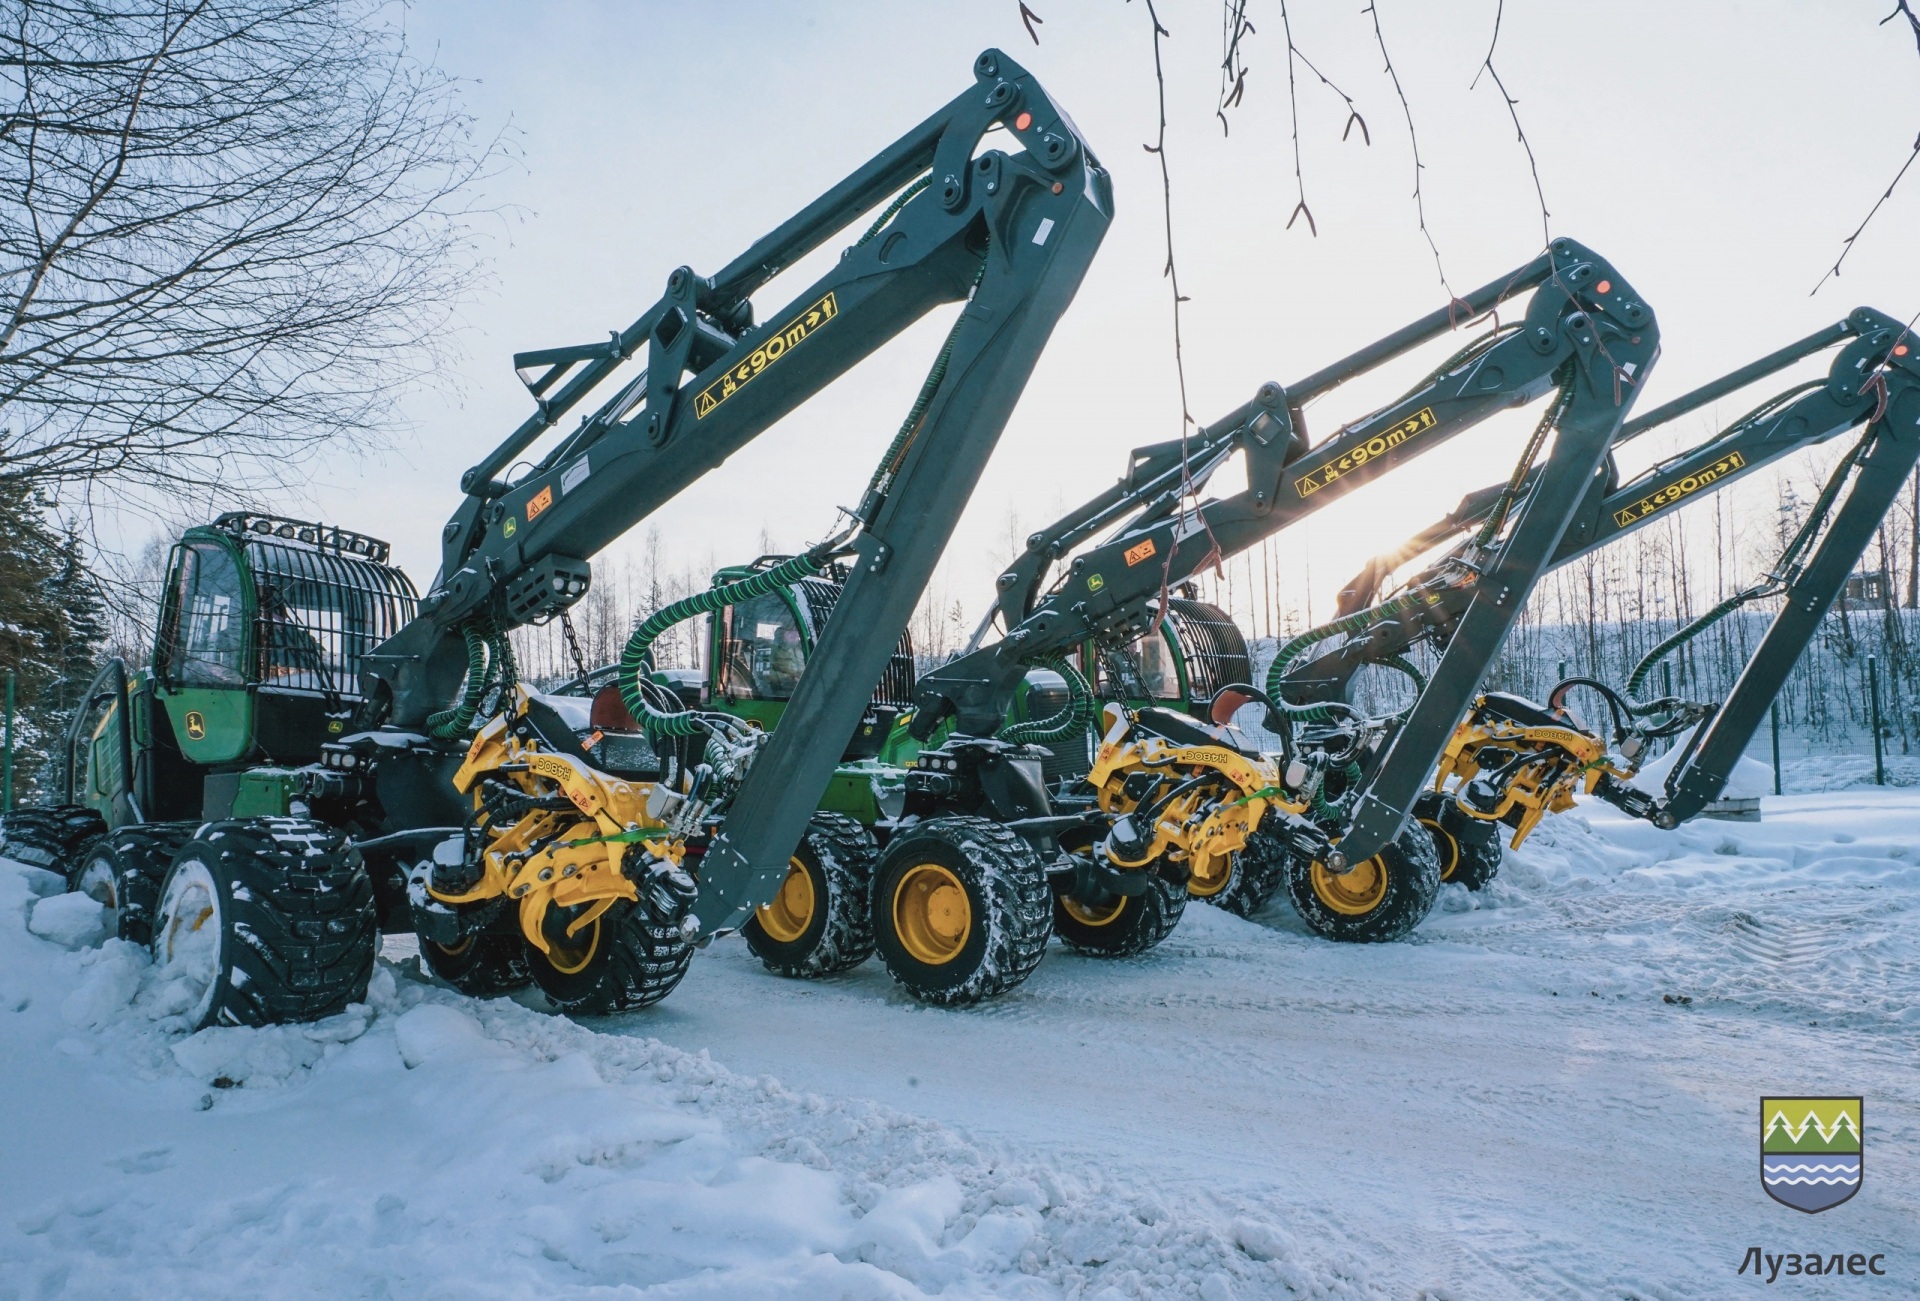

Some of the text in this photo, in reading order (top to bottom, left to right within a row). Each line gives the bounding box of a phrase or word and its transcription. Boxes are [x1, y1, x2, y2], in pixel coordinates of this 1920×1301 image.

[751, 323, 807, 374] 90m
[1351, 428, 1407, 466] 90m
[1666, 469, 1717, 501] 90m
[1535, 729, 1572, 741] H480C
[537, 757, 572, 782] H480C
[1186, 750, 1227, 764] H480C
